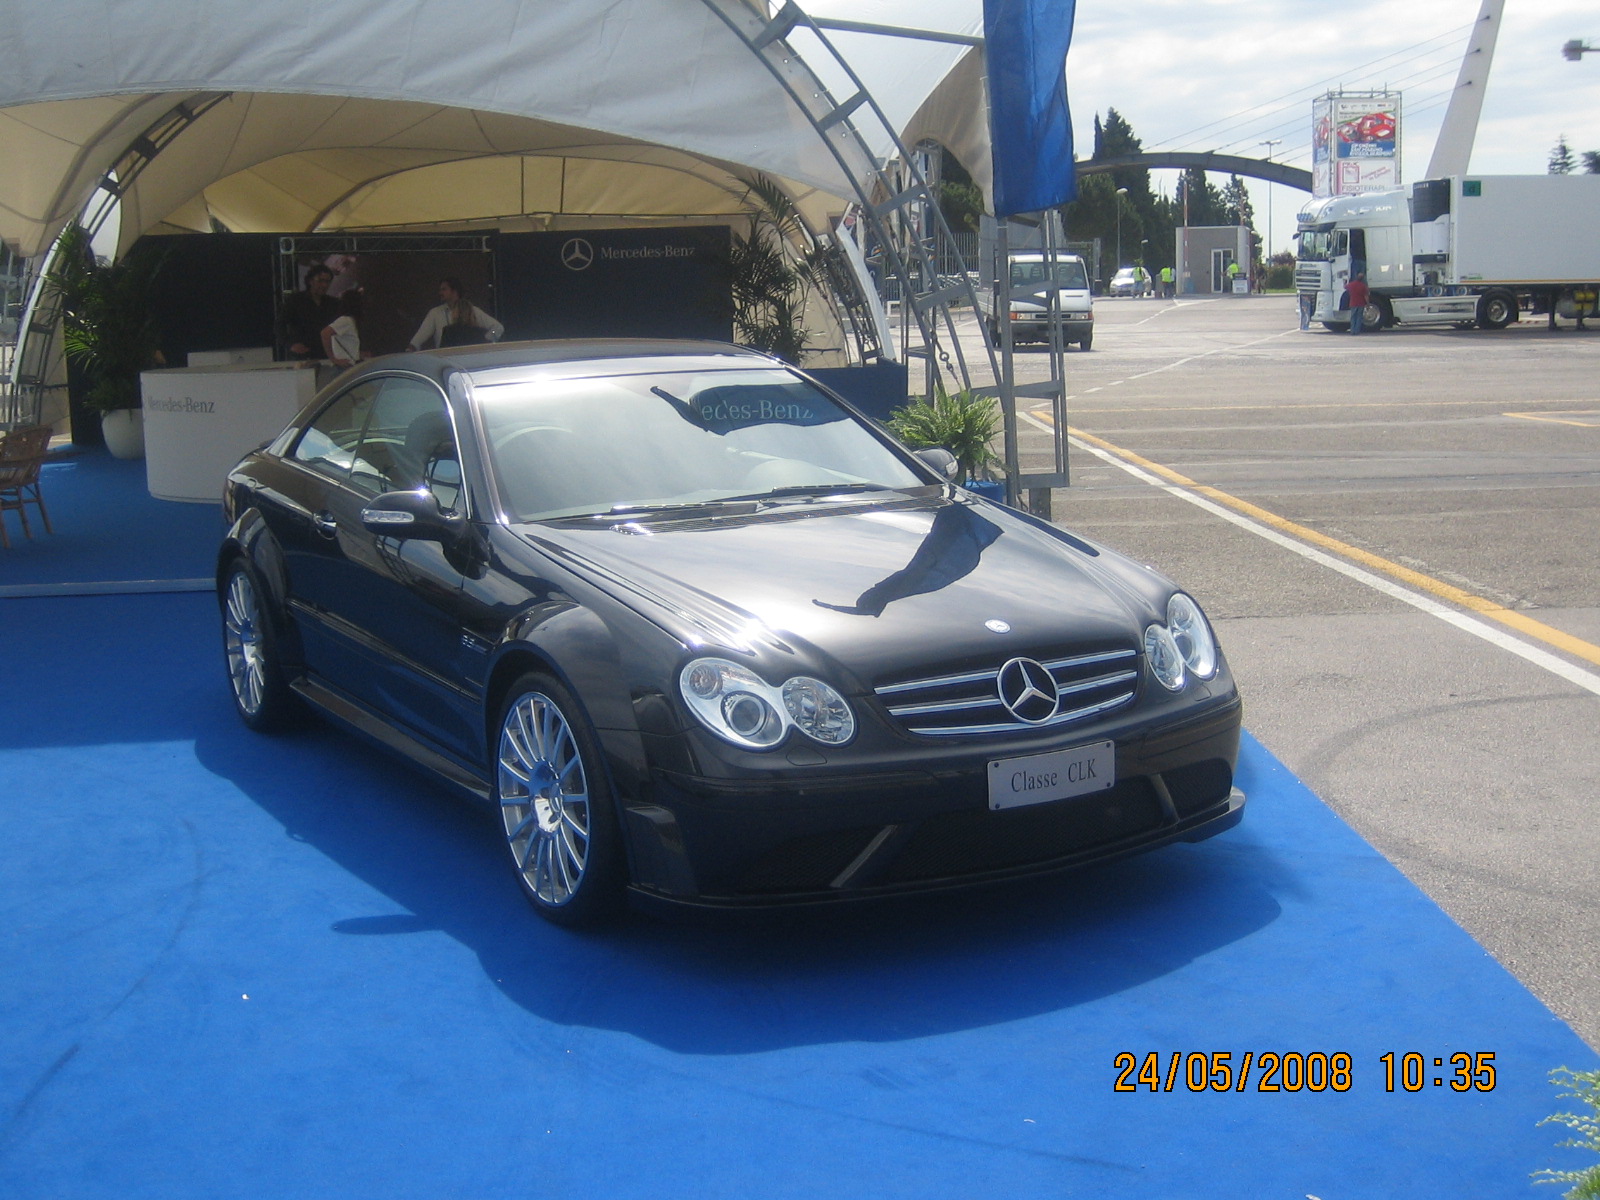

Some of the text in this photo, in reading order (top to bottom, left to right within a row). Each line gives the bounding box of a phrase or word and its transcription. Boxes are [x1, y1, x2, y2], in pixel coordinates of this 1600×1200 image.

[601, 245, 696, 259] Mercedes-Benz
[1011, 758, 1097, 793] Classe CLK
